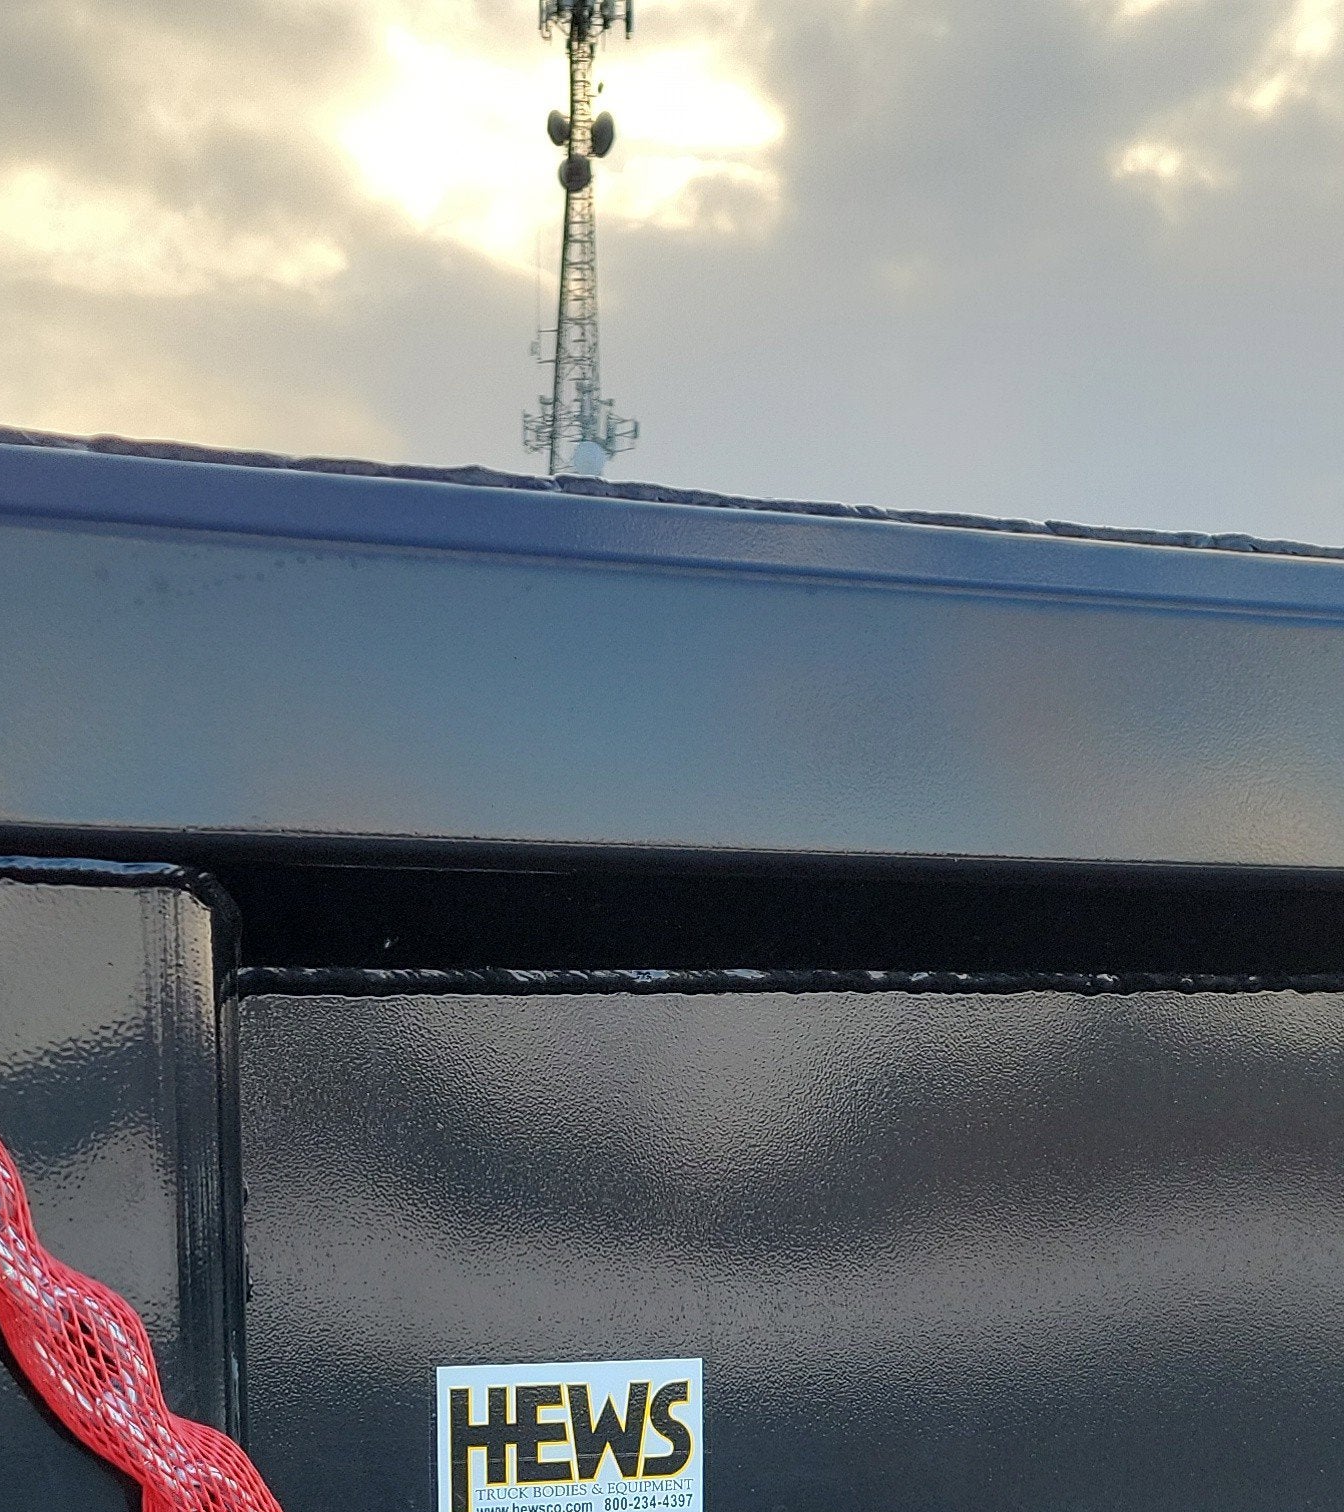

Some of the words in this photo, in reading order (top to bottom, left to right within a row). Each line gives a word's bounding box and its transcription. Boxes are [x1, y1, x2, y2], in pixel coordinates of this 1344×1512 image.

[476, 1486, 530, 1500] TRUCK
[533, 1484, 587, 1498] BODIES
[591, 1483, 604, 1495] &
[607, 1479, 693, 1494] EQUIPMENT
[604, 1493, 694, 1511] 800-234-4397
